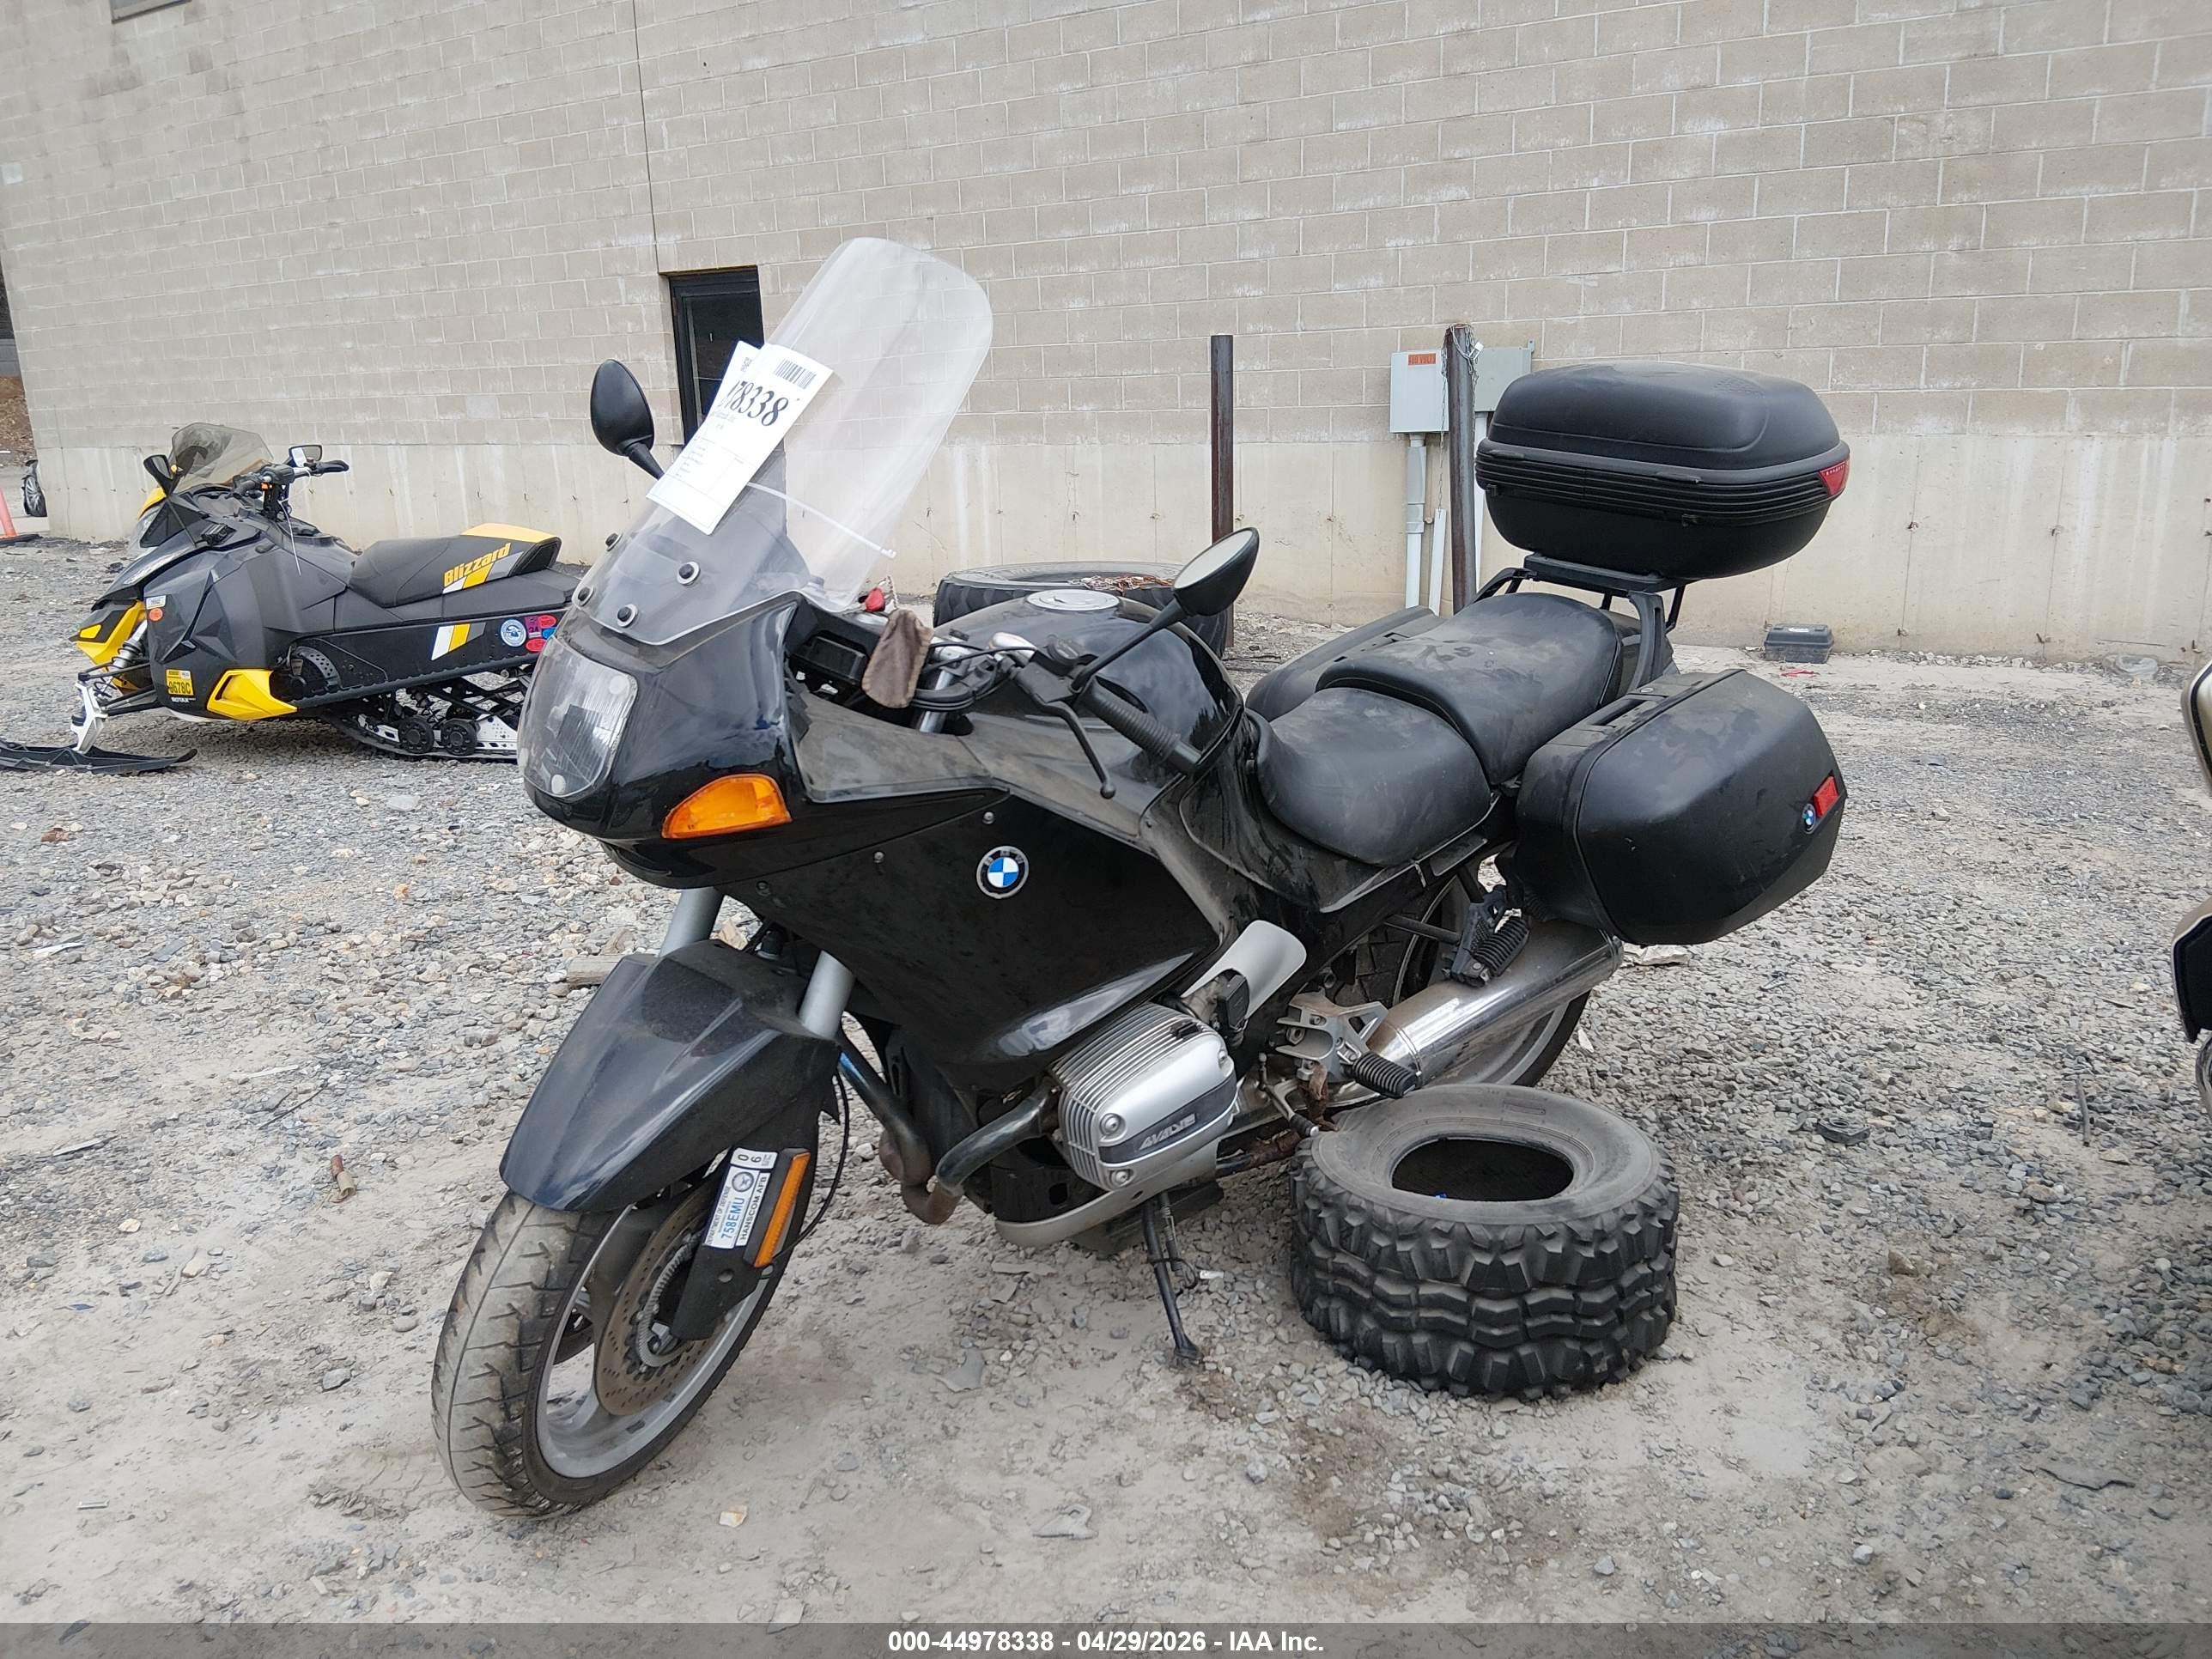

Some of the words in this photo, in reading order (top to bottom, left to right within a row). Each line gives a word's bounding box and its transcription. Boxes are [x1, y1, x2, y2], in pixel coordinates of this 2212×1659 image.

[443, 543, 512, 587] Blizzard
[720, 1197, 744, 1239] 758EMU
[739, 1195, 760, 1240] HANSCOM
